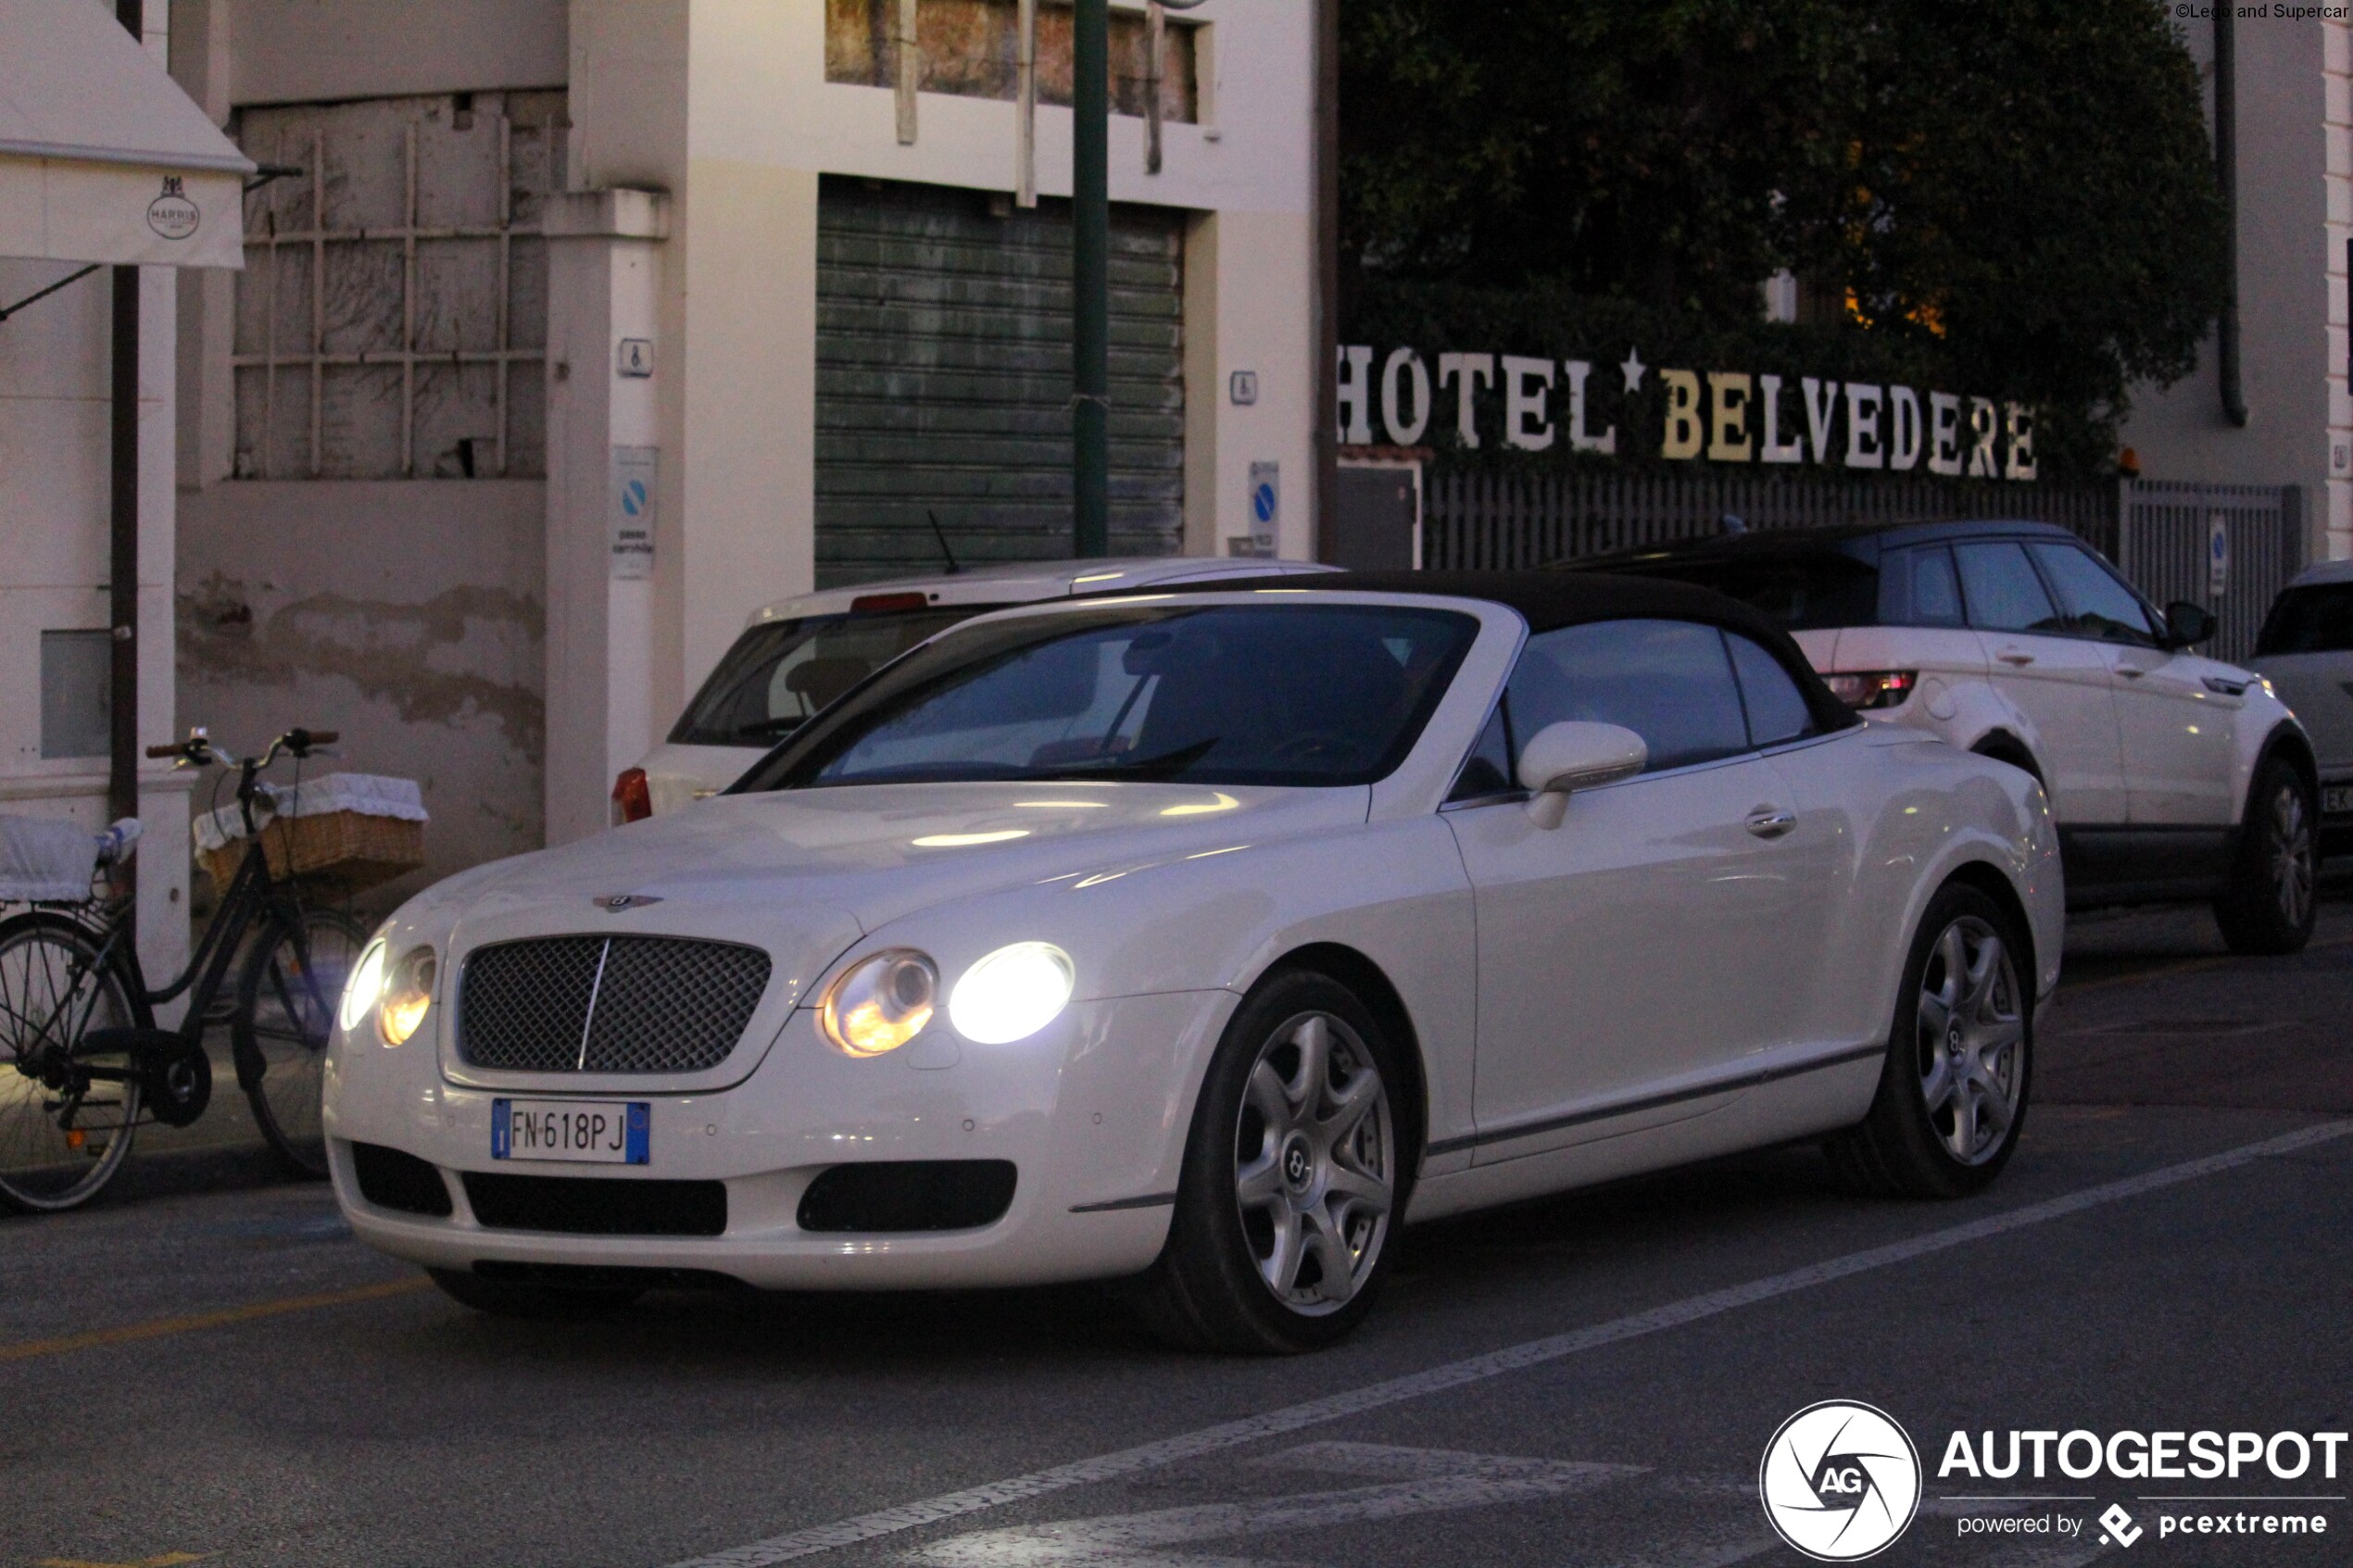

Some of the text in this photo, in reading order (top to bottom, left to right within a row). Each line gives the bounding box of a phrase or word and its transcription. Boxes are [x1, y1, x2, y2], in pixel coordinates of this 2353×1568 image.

[151, 209, 195, 221] HARRIS
[1337, 345, 2037, 481] HOTEL BELVEDERE
